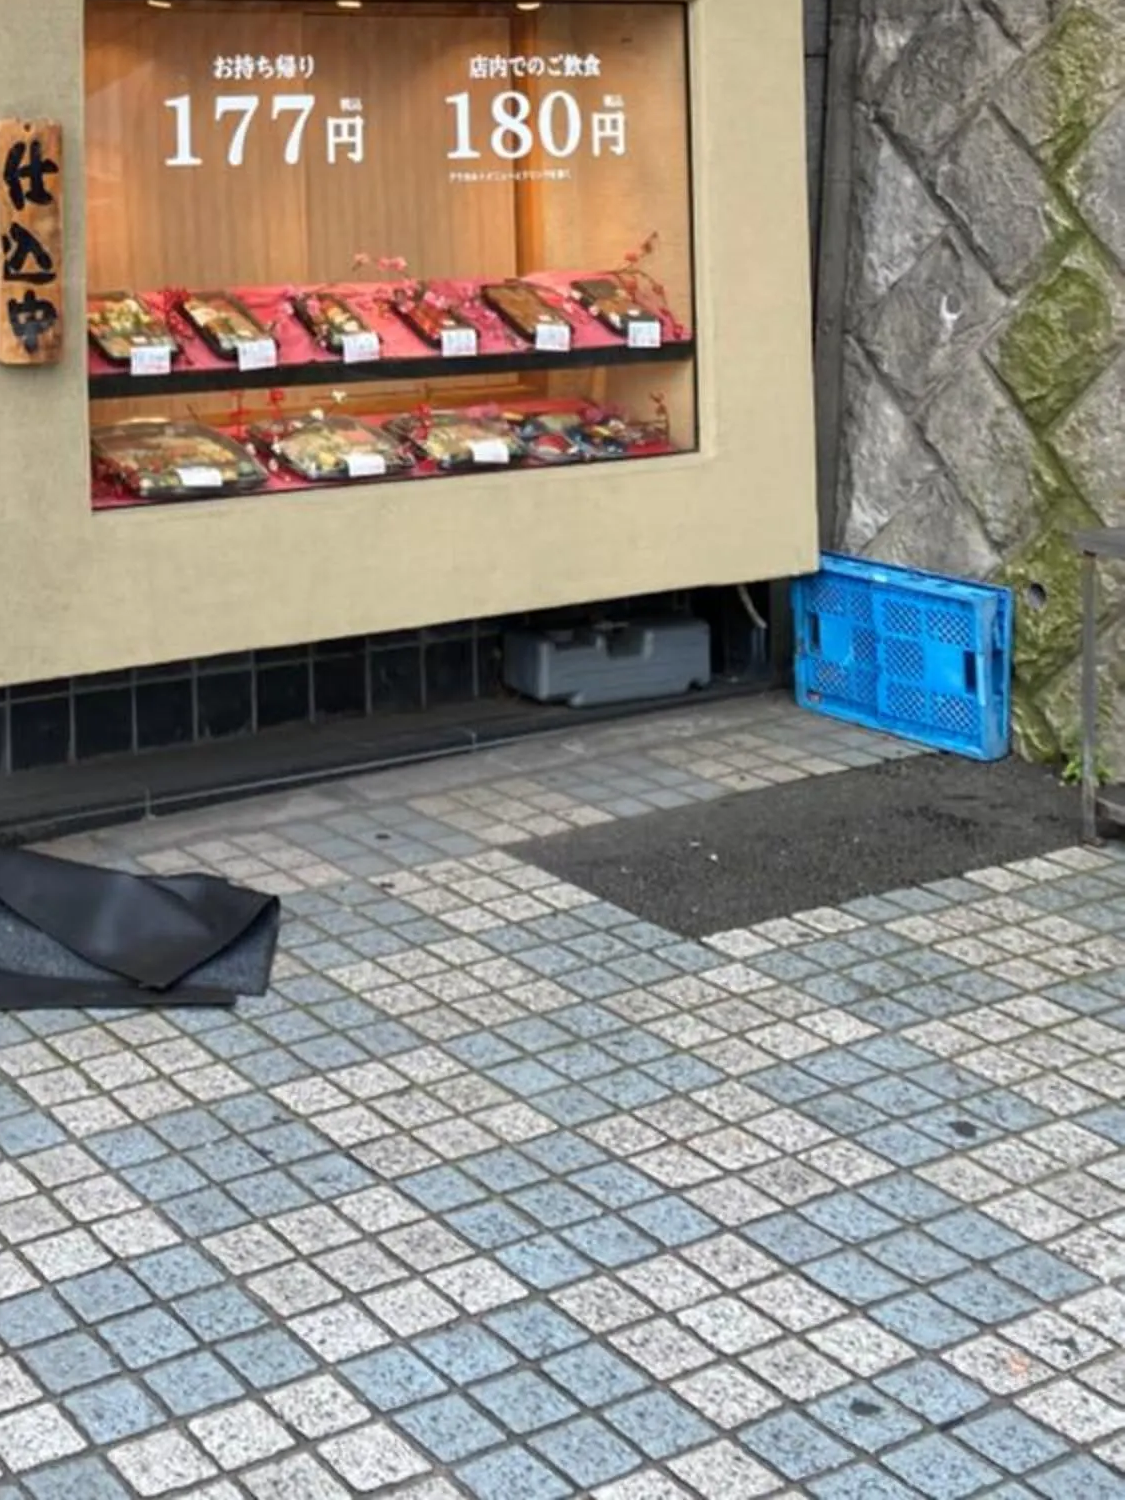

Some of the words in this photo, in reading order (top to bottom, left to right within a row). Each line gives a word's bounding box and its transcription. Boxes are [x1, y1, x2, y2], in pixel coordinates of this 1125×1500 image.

[213, 55, 315, 78] お持ち帰り
[469, 53, 601, 79] 店内でのご飲食
